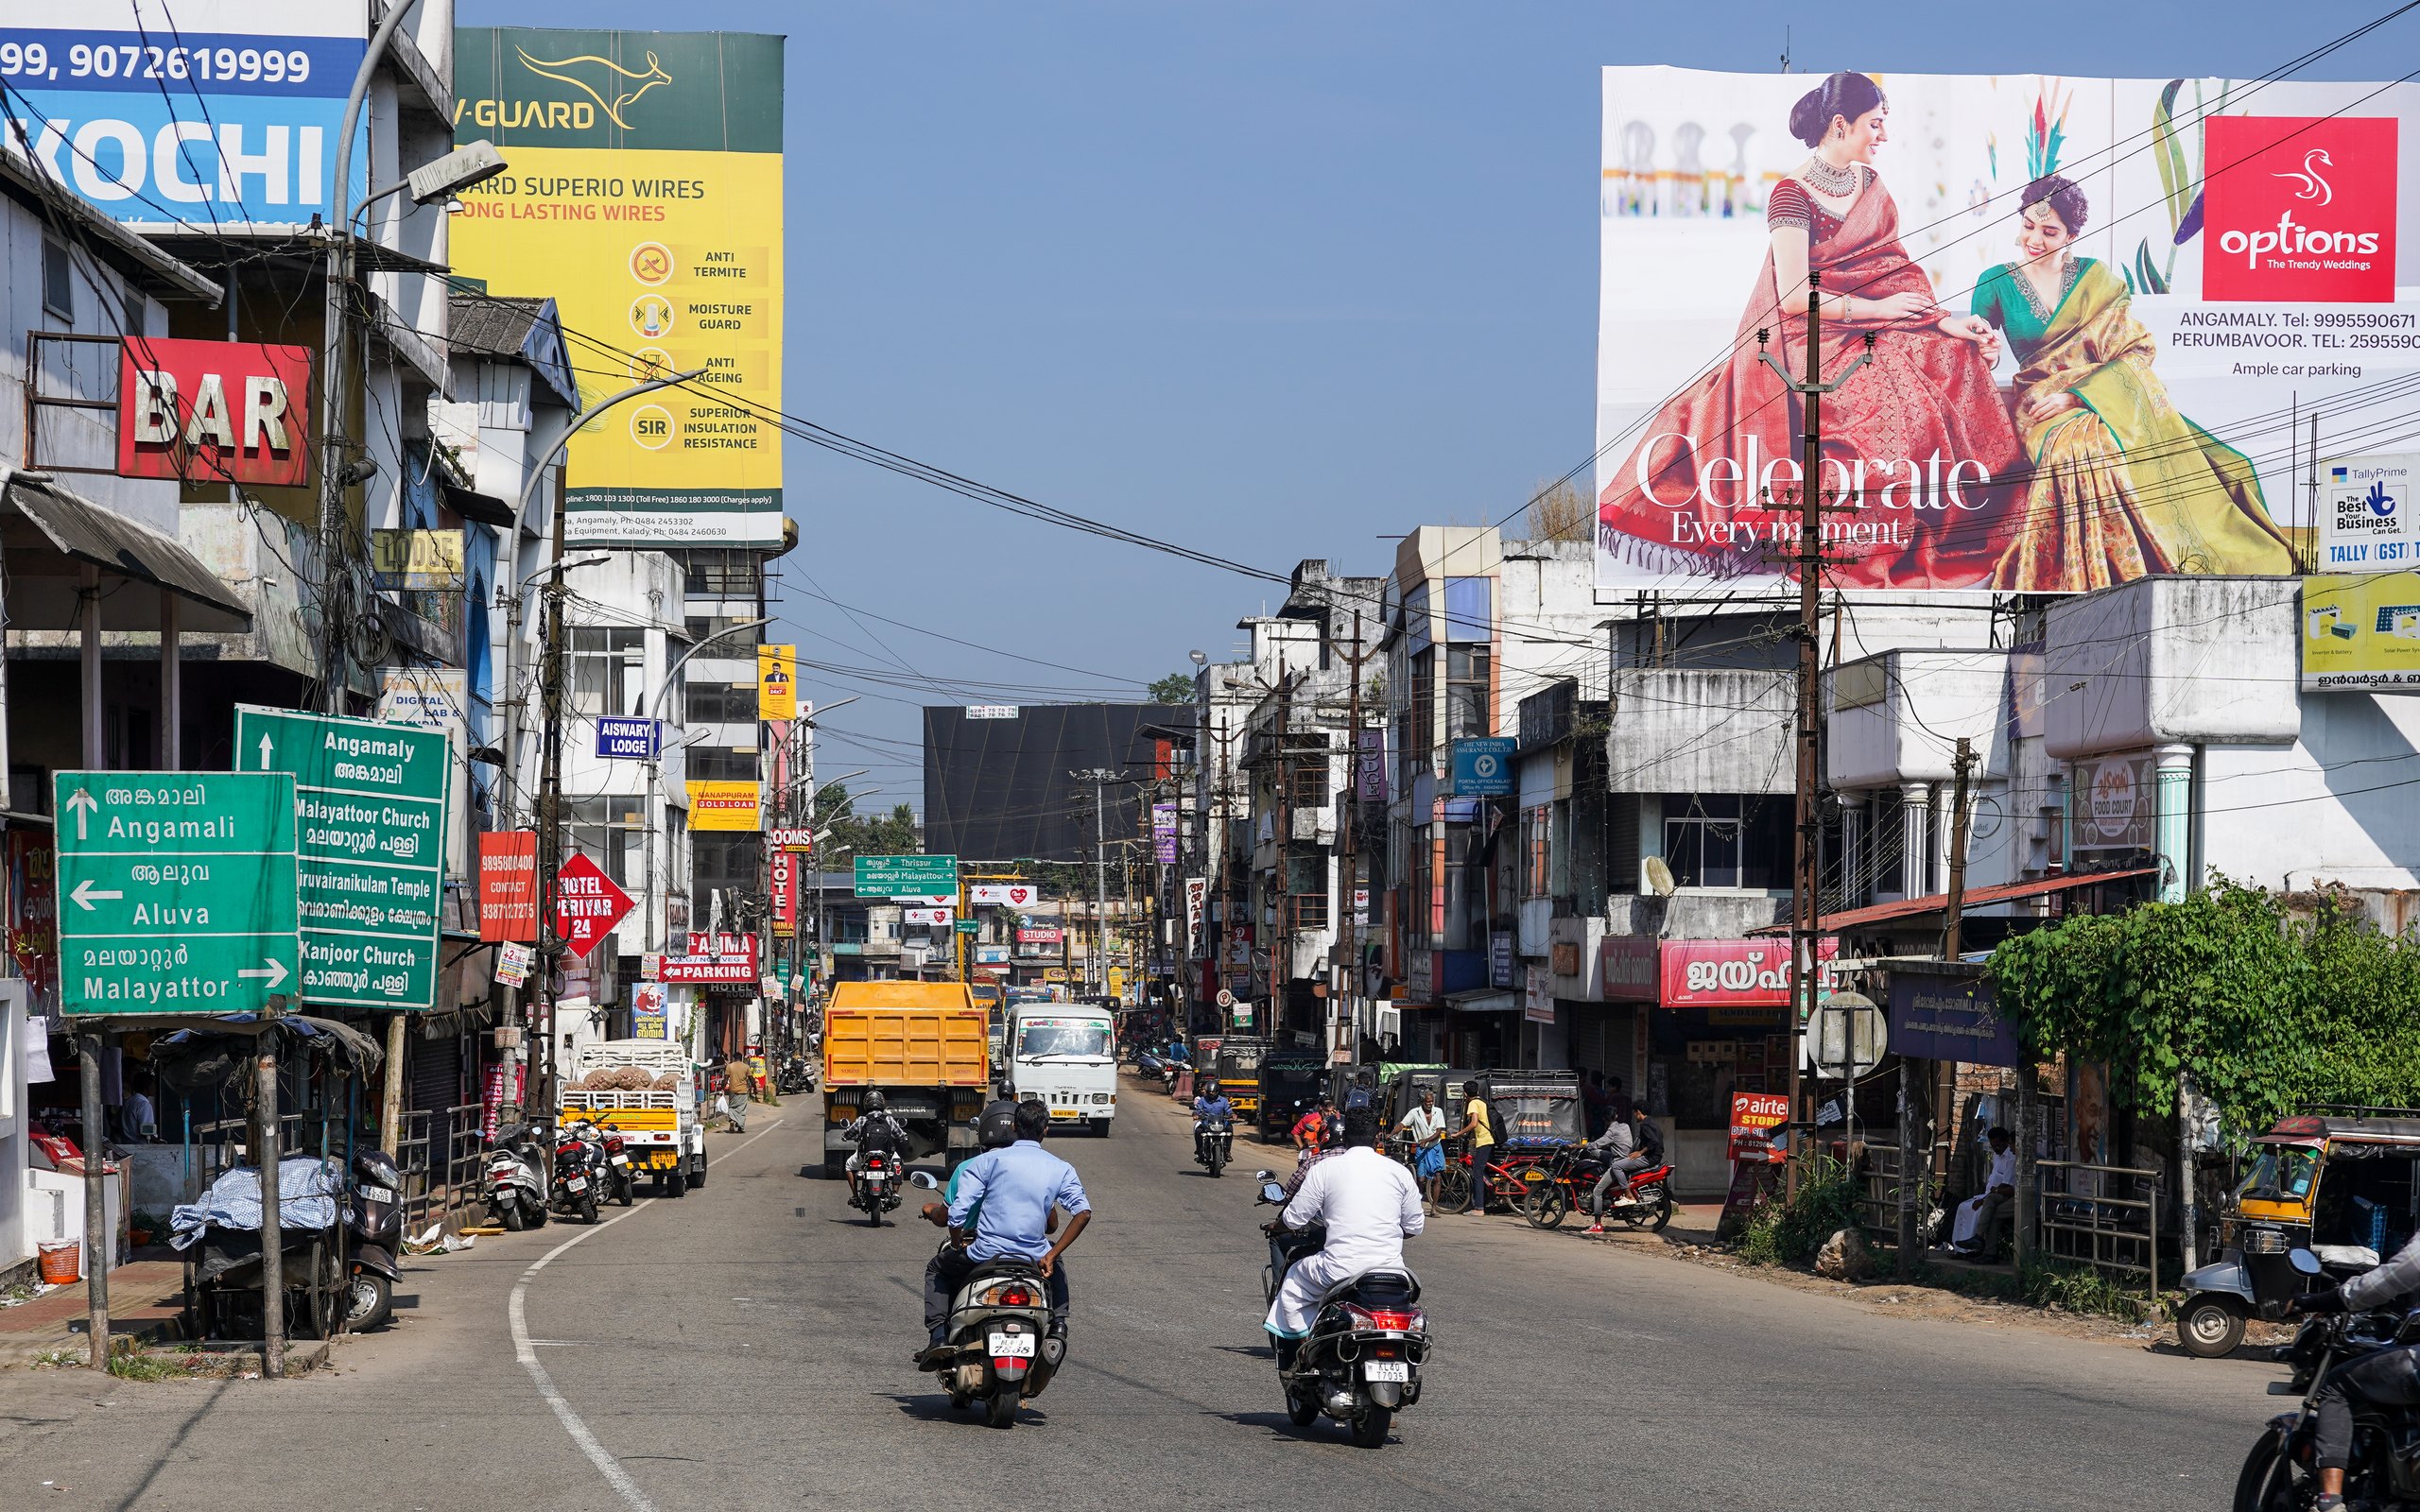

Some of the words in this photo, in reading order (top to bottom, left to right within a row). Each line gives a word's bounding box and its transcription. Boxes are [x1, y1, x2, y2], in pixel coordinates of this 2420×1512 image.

[70, 44, 310, 83] 9072619999
[5, 118, 323, 205] KOCHI
[525, 177, 624, 198] SUPERIO
[631, 179, 705, 199] WIRES
[510, 202, 596, 220] LASTING
[603, 204, 666, 222] WIRES
[2220, 209, 2380, 270] options
[705, 251, 735, 263] ANTI
[693, 266, 747, 279] TERMITE
[2267, 259, 2286, 269] The
[2288, 259, 2322, 270] Trendy
[2323, 259, 2372, 271] Weddings
[689, 303, 752, 316] MOISTURE
[699, 318, 742, 331] GUARD
[2180, 312, 2278, 327] ANGAMALY.
[2282, 313, 2309, 328] Tel:
[2313, 313, 2416, 329] 9995590671
[2172, 332, 2308, 349] PERUMBAVOOR.
[2312, 334, 2346, 349] TEL:
[705, 356, 735, 369] ANTI
[698, 372, 743, 384] AGEING
[2232, 362, 2279, 378] Ample
[2282, 364, 2305, 376] car
[2308, 362, 2362, 379] parking
[134, 369, 290, 449] BAR
[690, 407, 752, 419] SUPERIOR
[638, 420, 666, 436] SIR
[683, 422, 758, 435] INSULATION
[683, 438, 758, 450] RESISTANCE
[2352, 467, 2408, 480] TallyPrime
[585, 494, 602, 503] 1800
[604, 494, 616, 503] 103
[720, 495, 751, 506] (Charges
[751, 495, 772, 506] apply)
[2337, 500, 2367, 514] Best
[2346, 495, 2360, 504] The
[577, 516, 619, 526] Angamaly,
[635, 517, 656, 525] 0484
[658, 518, 694, 526] 2453302
[2337, 517, 2397, 530] Business
[2344, 512, 2361, 521] Your
[574, 527, 621, 537] Equipment,
[622, 527, 652, 537] Kalady,
[668, 527, 689, 536] 0484
[691, 527, 727, 536] 2460630
[1669, 511, 1764, 552] Every
[2372, 527, 2386, 536] Can
[383, 536, 454, 568] LODGE
[2329, 544, 2368, 563] TALLY
[2374, 541, 2410, 561] (GST)
[396, 696, 444, 705] DIGITAL
[424, 709, 448, 717] LAB
[324, 731, 415, 762] Angamaly
[611, 737, 647, 754] LODGE
[335, 762, 403, 785] അങ്കമാലി
[106, 784, 206, 805] അങ്കമാലി
[2095, 800, 2111, 815] FOOD
[2112, 799, 2133, 814] COURT
[382, 807, 430, 830] Church
[107, 816, 235, 844] Angamali
[380, 833, 419, 857] പള്ളി
[482, 854, 533, 870] 9895800400
[901, 859, 932, 868] Thrissur
[131, 864, 211, 886] ആലുവ
[901, 872, 944, 881] Malayattoor
[390, 876, 431, 899] Temple
[490, 882, 526, 893] CONTACT
[774, 855, 789, 920] HOTEL
[902, 885, 922, 894] Aluva
[132, 902, 210, 925] Aluva
[482, 902, 534, 919] 9387127275
[573, 919, 592, 934] 24
[1024, 930, 1057, 939] STUDIO
[300, 940, 361, 966] Kanjoor
[363, 944, 416, 967] Church
[683, 966, 752, 979] PARKING
[84, 977, 230, 1005] Malayattor
[372, 971, 408, 996] പള്ളി
[710, 984, 752, 992] HOTEL
[898, 1105, 926, 1113] EICHER
